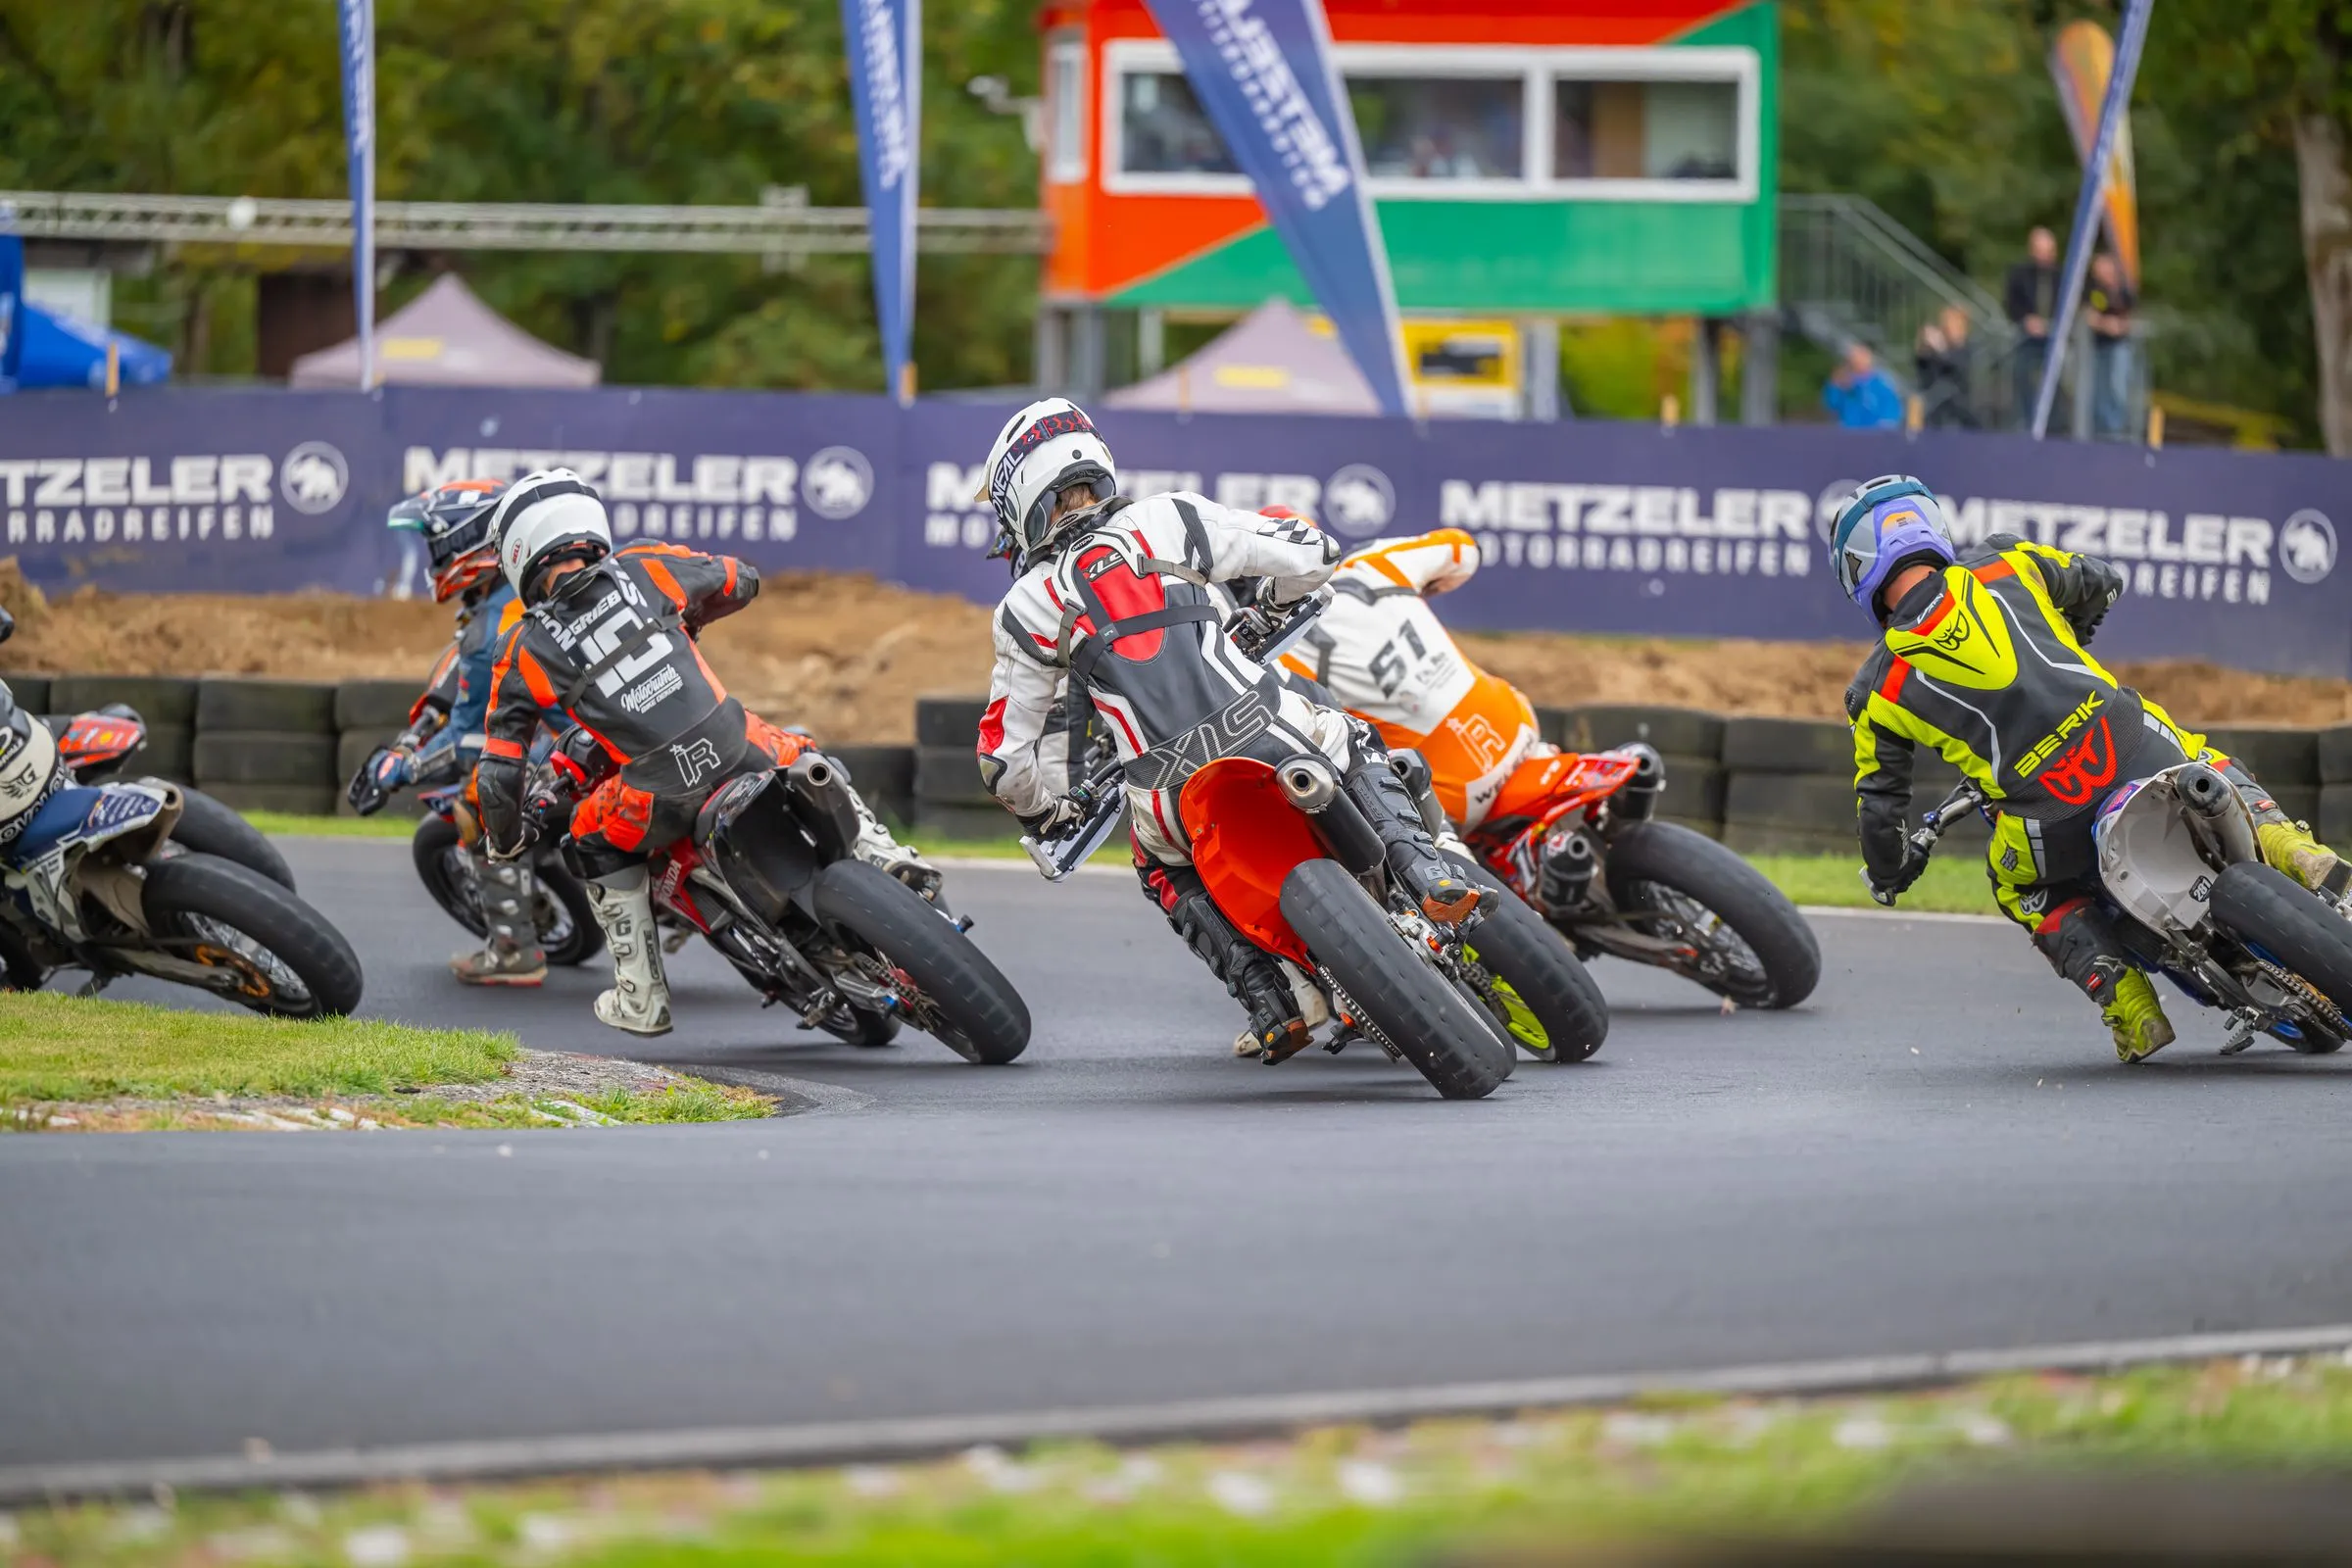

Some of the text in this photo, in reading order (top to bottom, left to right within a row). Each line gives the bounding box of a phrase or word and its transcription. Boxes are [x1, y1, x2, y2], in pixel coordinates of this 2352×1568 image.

[0, 454, 273, 508] TZELER
[612, 503, 799, 542] DREIFEN
[1440, 480, 1812, 539] METZELER
[1938, 494, 2275, 567] METZELER
[1480, 530, 1811, 576] OTORRADREIFEN
[1367, 618, 1427, 700] 51
[2014, 690, 2104, 778] BERIK
[2193, 878, 2212, 901] 281
